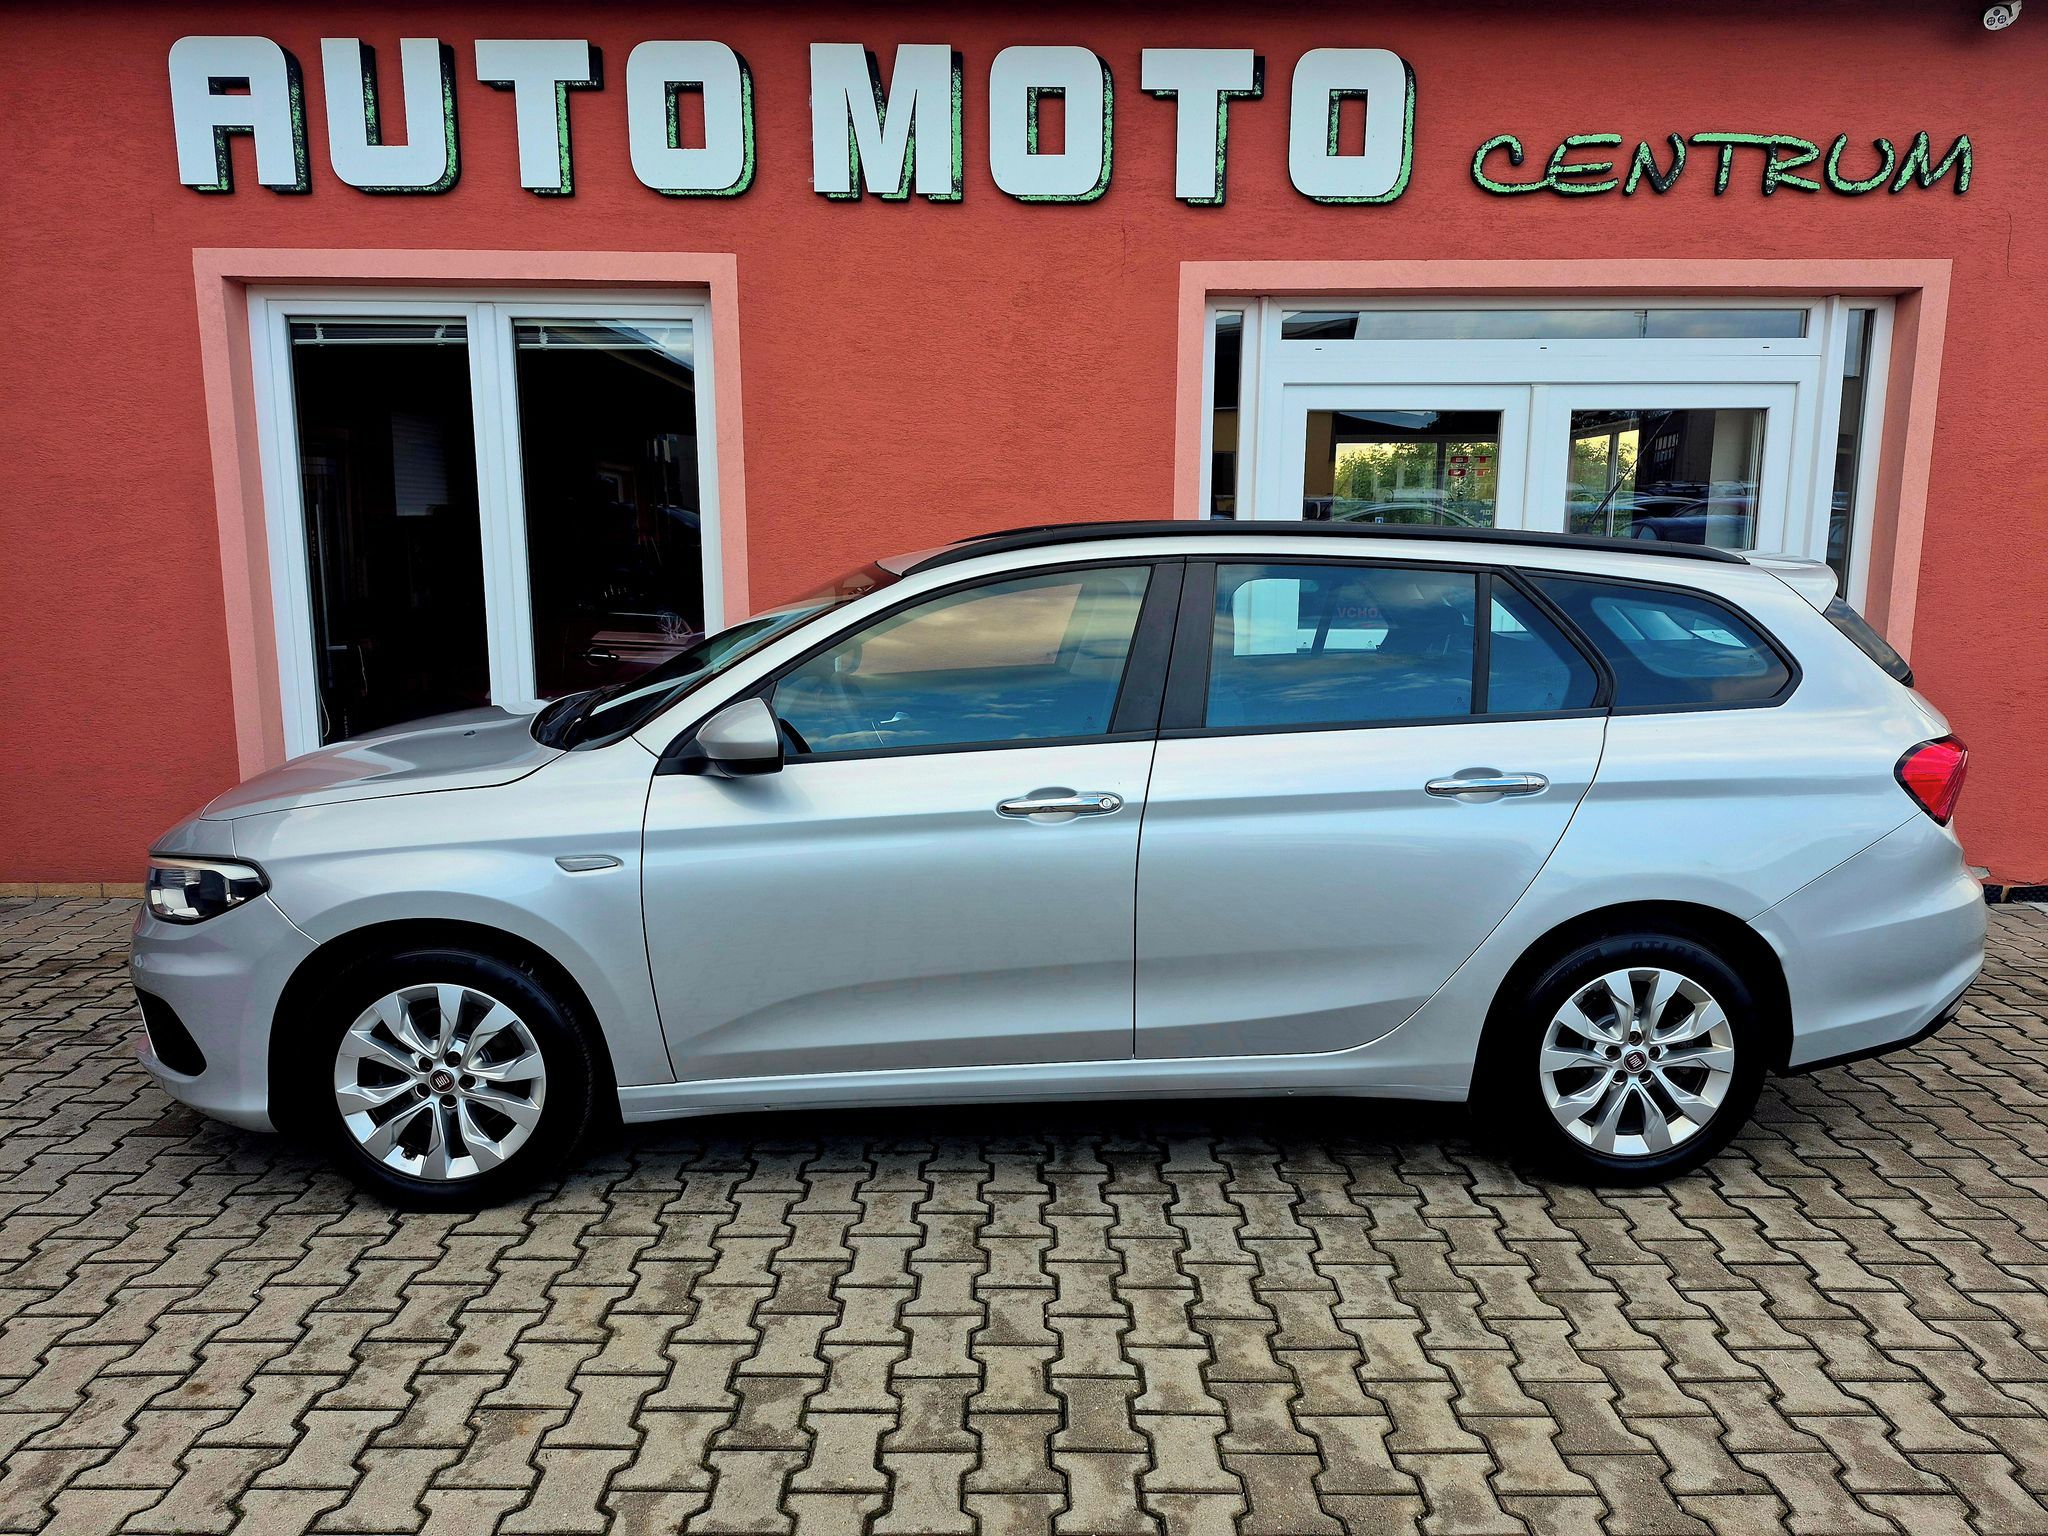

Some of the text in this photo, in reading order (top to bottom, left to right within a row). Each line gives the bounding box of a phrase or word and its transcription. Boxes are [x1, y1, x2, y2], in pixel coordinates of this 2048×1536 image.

[168, 36, 1973, 206] AUTO MOTO CENTRUM
